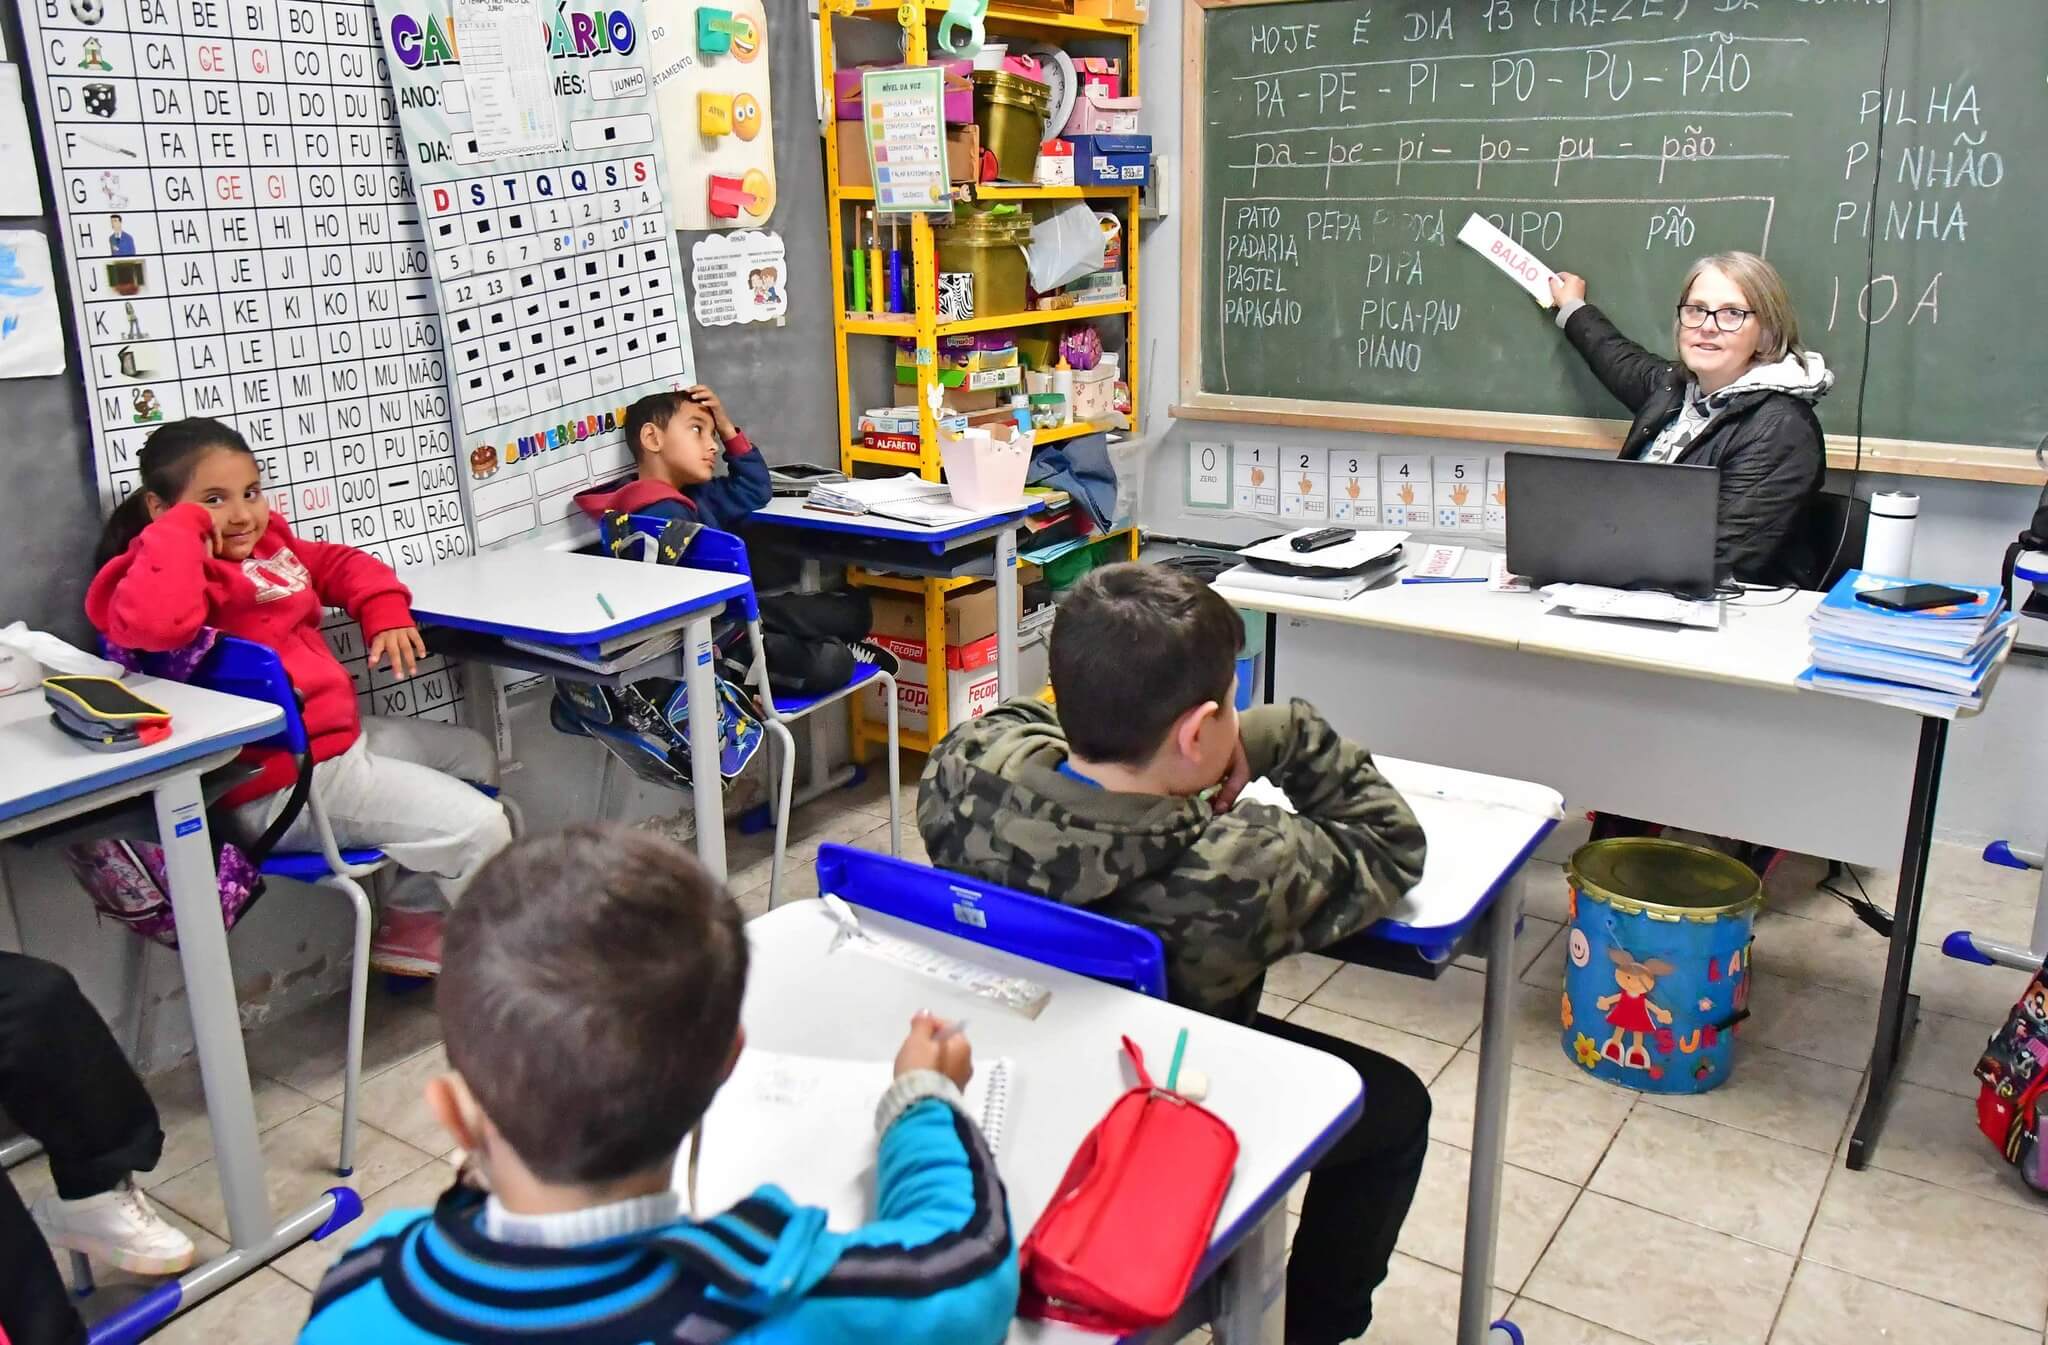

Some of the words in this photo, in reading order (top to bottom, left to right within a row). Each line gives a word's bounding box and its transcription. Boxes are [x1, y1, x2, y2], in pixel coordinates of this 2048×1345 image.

[139, 0, 168, 24] BA
[192, 1, 218, 28] BE
[246, 5, 264, 30] BI
[289, 8, 314, 34] BO
[335, 12, 358, 37] BU
[1251, 24, 1320, 54] HOJE
[1353, 9, 1372, 45] É
[1403, 8, 1453, 41] DIA
[1482, 0, 1513, 32] 13
[51, 39, 66, 66] C
[146, 43, 175, 70] CA
[198, 46, 225, 72] CE
[252, 48, 270, 74] CI
[294, 51, 320, 76] CO
[340, 53, 363, 78] CU
[1254, 79, 1286, 118] PA
[1320, 72, 1357, 114] PE
[1409, 63, 1437, 104] PI
[1491, 58, 1535, 105] PO
[1585, 50, 1633, 101] PU
[1682, 31, 1751, 97] PÃO
[401, 85, 441, 109] ANO:
[614, 73, 643, 92] JUNHO
[57, 86, 72, 112] D
[152, 88, 181, 114] DA
[204, 90, 231, 115] DE
[256, 91, 275, 116] DI
[299, 93, 325, 117] DO
[344, 94, 367, 118] DU
[1860, 83, 1981, 125] PILHA
[65, 133, 76, 158] F
[160, 133, 186, 158] FA
[211, 133, 236, 158] FE
[263, 134, 279, 157] FI
[305, 134, 329, 158] FO
[350, 134, 371, 157] FU
[418, 141, 452, 164] DIA:
[1252, 143, 1297, 189] pa
[1325, 137, 1363, 190] pe
[1396, 133, 1425, 186] pi
[1477, 134, 1512, 190] po
[1554, 135, 1594, 187] pu
[1659, 125, 1716, 184] pão
[1846, 130, 2003, 190] PNHÃO
[72, 178, 87, 204] G
[165, 176, 194, 202] GA
[216, 176, 243, 200] GE
[268, 175, 286, 199] GI
[309, 174, 335, 198] GO
[354, 174, 376, 197] GU
[433, 189, 449, 212] D
[471, 184, 485, 206] S
[503, 179, 516, 200] T
[536, 175, 553, 196] Q
[571, 170, 588, 191] Q
[605, 166, 617, 186] S
[634, 162, 646, 182] S
[550, 209, 558, 223] 1
[583, 204, 591, 218] 2
[614, 199, 621, 213] 3
[642, 191, 649, 203] 4
[1834, 201, 1968, 243] PINHA
[79, 223, 93, 248] H
[171, 219, 200, 244] HA
[222, 217, 248, 242] HE
[273, 216, 291, 239] HI
[314, 214, 339, 237] HO
[358, 213, 380, 235] HU
[450, 254, 459, 270] 5
[487, 250, 495, 265] 6
[520, 246, 527, 260] 7
[554, 237, 562, 252] 8
[587, 232, 595, 246] 9
[612, 226, 626, 242] 10
[642, 220, 657, 235] 11
[1238, 207, 1280, 230] PATO
[1307, 211, 1362, 241] PEPA
[1646, 206, 1695, 250] PÃO
[1227, 234, 1299, 267] PADARIA
[1490, 240, 1539, 282] BALÃO
[89, 267, 98, 292] J
[181, 261, 204, 287] JA
[231, 258, 252, 283] JE
[281, 256, 294, 280] JI
[322, 253, 342, 277] JO
[365, 251, 383, 274] JU
[400, 247, 428, 274] JÃO
[1228, 264, 1288, 292] PASTEL
[1367, 251, 1423, 288] PIPA
[456, 286, 473, 303] 12
[487, 279, 503, 296] 13
[94, 311, 109, 335] K
[184, 303, 211, 328] KA
[234, 299, 259, 324] KE
[284, 296, 301, 319] KI
[324, 292, 347, 316] KO
[367, 289, 388, 312] KU
[1225, 299, 1301, 328] PAPAGAIO
[1360, 299, 1461, 336] PICA-PAU
[100, 354, 112, 379] L
[191, 344, 216, 370] LA
[240, 339, 263, 364] LE
[290, 335, 305, 359] LI
[329, 331, 351, 354] LO
[372, 326, 392, 350] LU
[407, 317, 437, 348] LÃO
[1358, 335, 1421, 372] PIANO
[105, 396, 121, 421] M
[194, 385, 224, 410] MA
[243, 379, 271, 404] ME
[293, 374, 312, 397] MI
[332, 368, 358, 392] MO
[374, 364, 398, 387] MU
[409, 358, 443, 383] MÃO
[112, 438, 127, 463] N
[249, 418, 274, 442] NE
[298, 412, 315, 435] NI
[337, 406, 361, 430] NO
[380, 400, 401, 423] NU
[414, 394, 446, 419] NÃO
[877, 439, 917, 451] ALFABETO
[304, 450, 320, 473] PI
[342, 443, 365, 466] PO
[384, 436, 405, 459] PU
[419, 430, 449, 455] PÃO
[1202, 448, 1215, 471] 0
[1253, 449, 1260, 461] 1
[1300, 455, 1309, 467] 2
[1349, 460, 1358, 473] 3
[1399, 464, 1410, 477] 4
[1454, 465, 1464, 478] 5
[303, 487, 329, 511] QUI
[342, 478, 375, 503] QUO
[422, 463, 455, 490] QUÃO
[1200, 475, 1217, 483] ZERO
[351, 515, 375, 539] RO
[393, 507, 415, 530] RU
[427, 499, 459, 525] RÃO
[401, 543, 423, 566] SU
[435, 534, 465, 560] SÃO
[969, 682, 997, 703] Fecop
